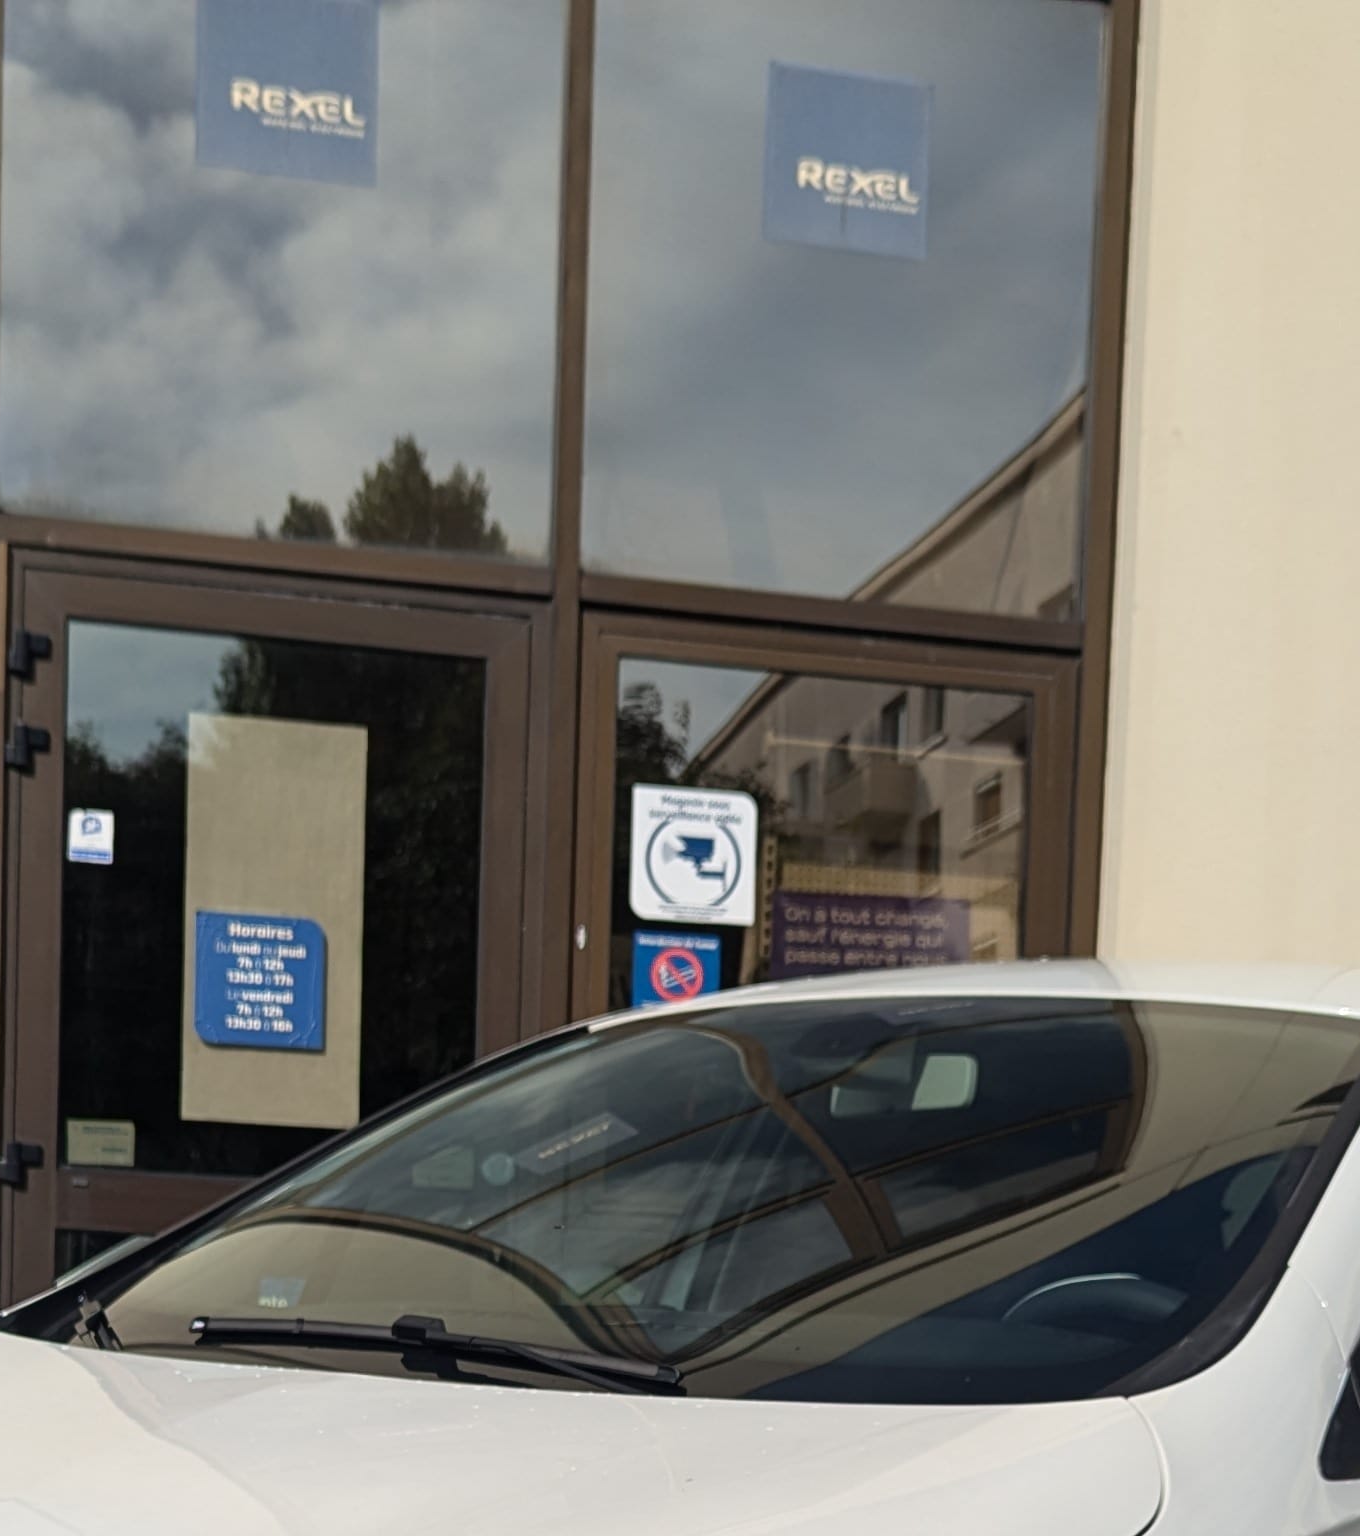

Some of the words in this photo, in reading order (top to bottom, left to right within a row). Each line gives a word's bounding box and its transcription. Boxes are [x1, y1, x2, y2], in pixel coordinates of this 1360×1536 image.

[231, 77, 367, 128] REXEL
[797, 157, 919, 205] REXEL
[784, 905, 811, 922] On
[830, 906, 871, 925] tout
[228, 921, 294, 940] Horaires
[784, 926, 828, 943] sauf
[915, 933, 944, 949] qui
[231, 940, 261, 956] lundi
[277, 944, 307, 960] jeudi
[784, 951, 840, 966] passe
[843, 950, 897, 967] entre
[237, 957, 253, 970] 7h
[262, 958, 285, 972] 12h
[226, 969, 263, 985] 13h30
[272, 973, 294, 987] 17h
[241, 989, 294, 1005] vendredi
[236, 1003, 252, 1016] 7h
[261, 1005, 284, 1018] 12h
[225, 1016, 262, 1031] 13h30
